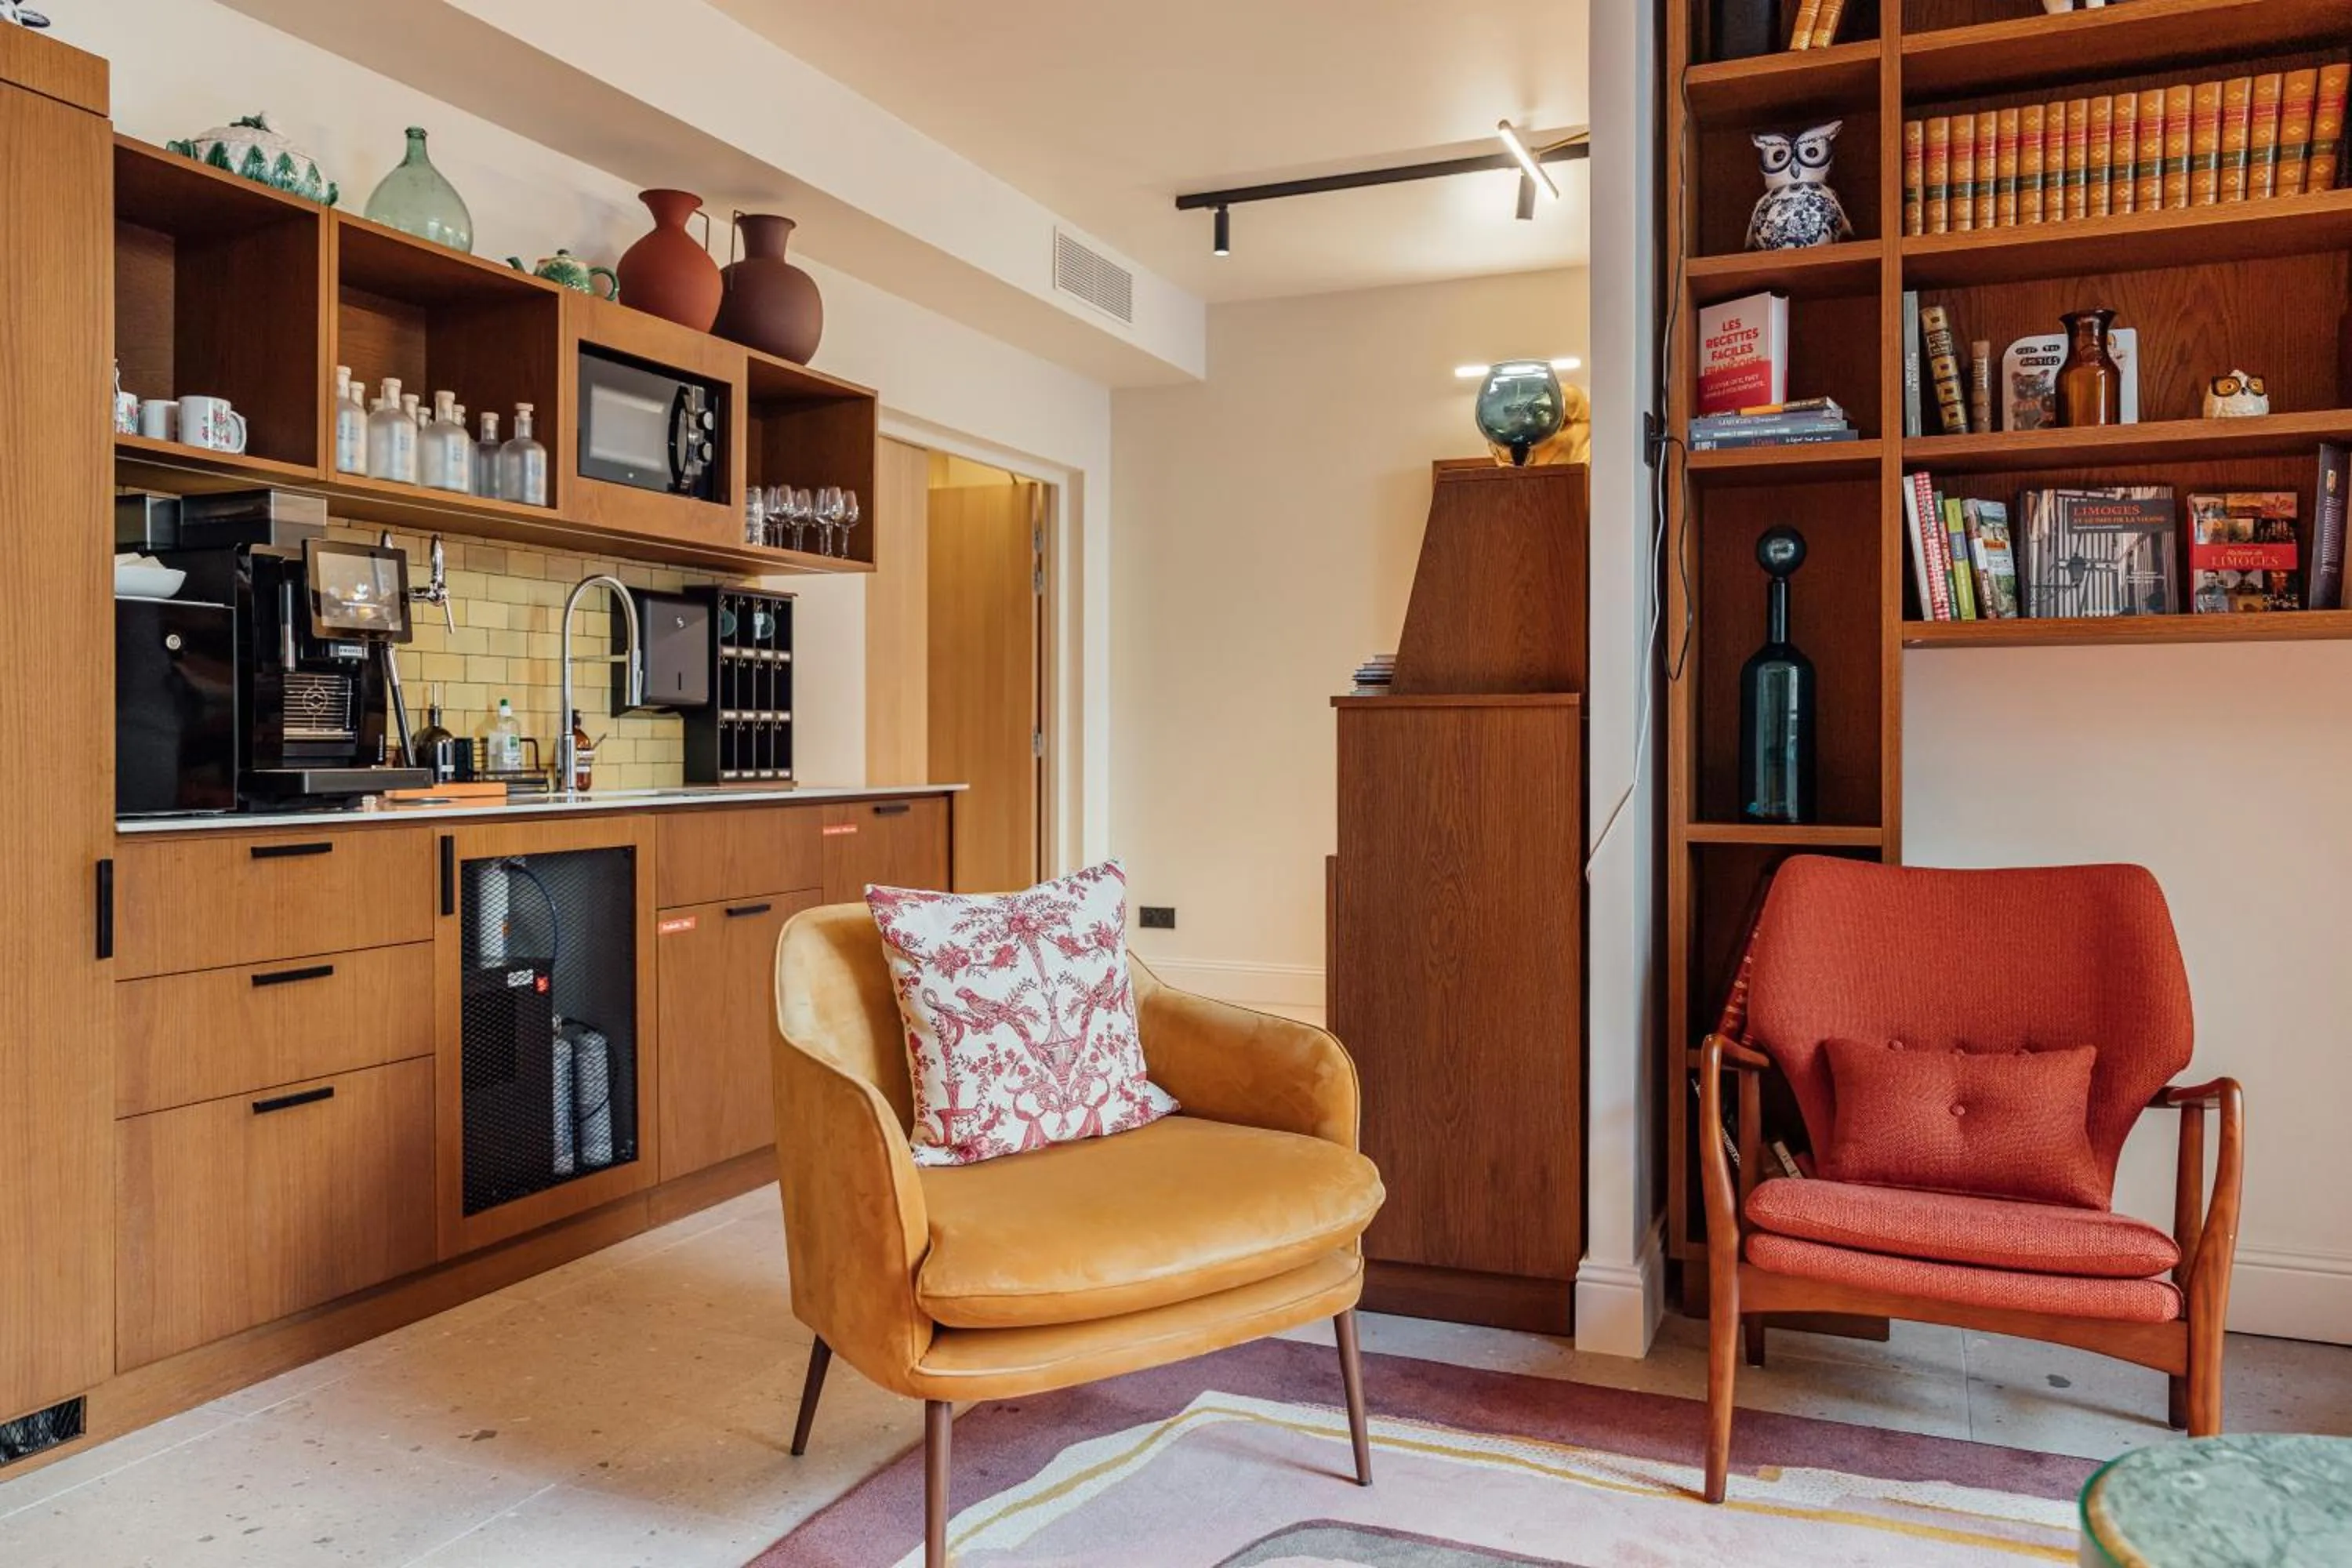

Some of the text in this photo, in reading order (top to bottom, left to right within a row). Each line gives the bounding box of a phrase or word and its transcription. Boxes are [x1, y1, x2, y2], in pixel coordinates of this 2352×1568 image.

[1722, 318, 1741, 332] LES
[1705, 327, 1759, 349] RECETTES
[1711, 343, 1753, 361] FACILES
[2073, 504, 2141, 516] LIMOGES
[2211, 555, 2279, 567] LIMOGES
